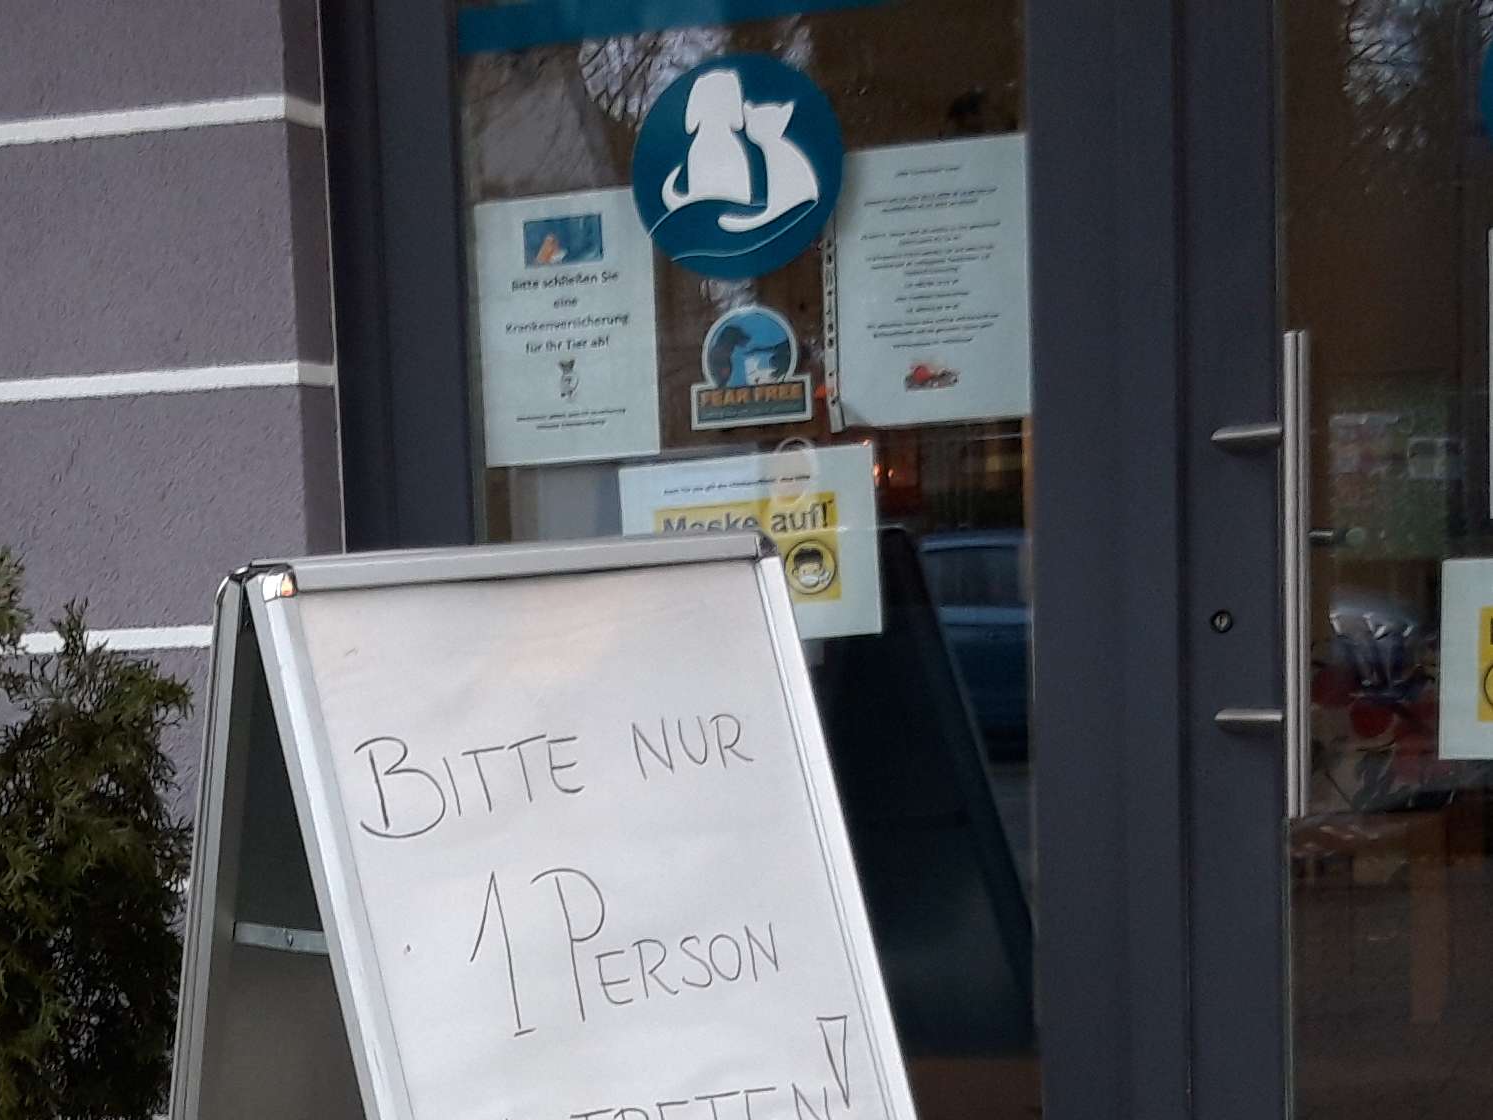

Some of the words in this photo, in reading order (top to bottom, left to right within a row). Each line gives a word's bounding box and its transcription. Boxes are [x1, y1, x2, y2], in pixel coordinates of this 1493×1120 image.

[601, 270, 619, 284] Sie
[553, 296, 578, 309] eine
[567, 338, 588, 350] Tier
[353, 731, 585, 839] BITTE
[632, 712, 755, 781] NUR
[469, 870, 538, 1038] 1
[531, 866, 782, 1023] PERSON
